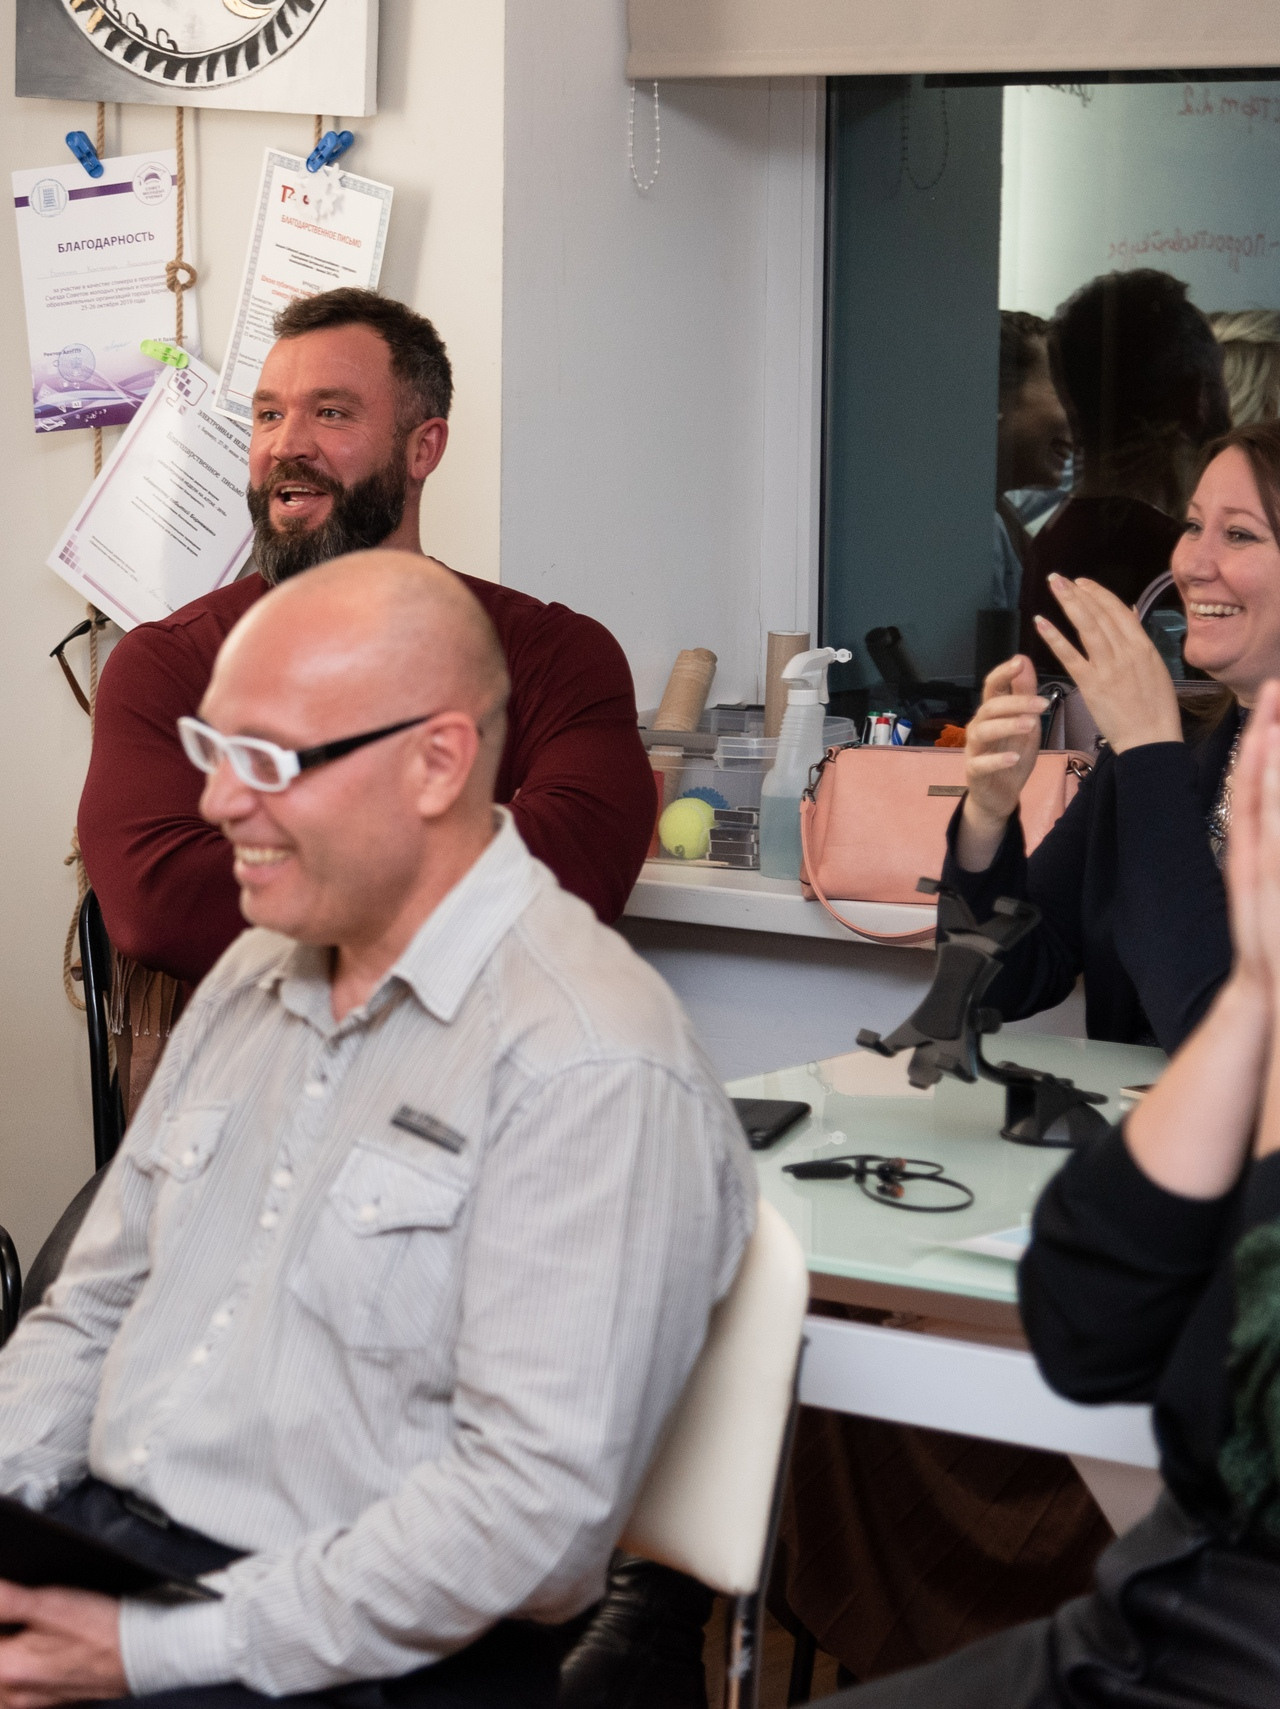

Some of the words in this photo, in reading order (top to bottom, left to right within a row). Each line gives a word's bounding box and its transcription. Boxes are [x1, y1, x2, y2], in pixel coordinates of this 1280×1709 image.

[58, 231, 155, 254] БЛАГОДАРНОСТЬ
[198, 409, 234, 440] ЭЛЕКТРОННАЯ
[166, 431, 221, 479] Благодарственное
[221, 476, 245, 498] письмо
